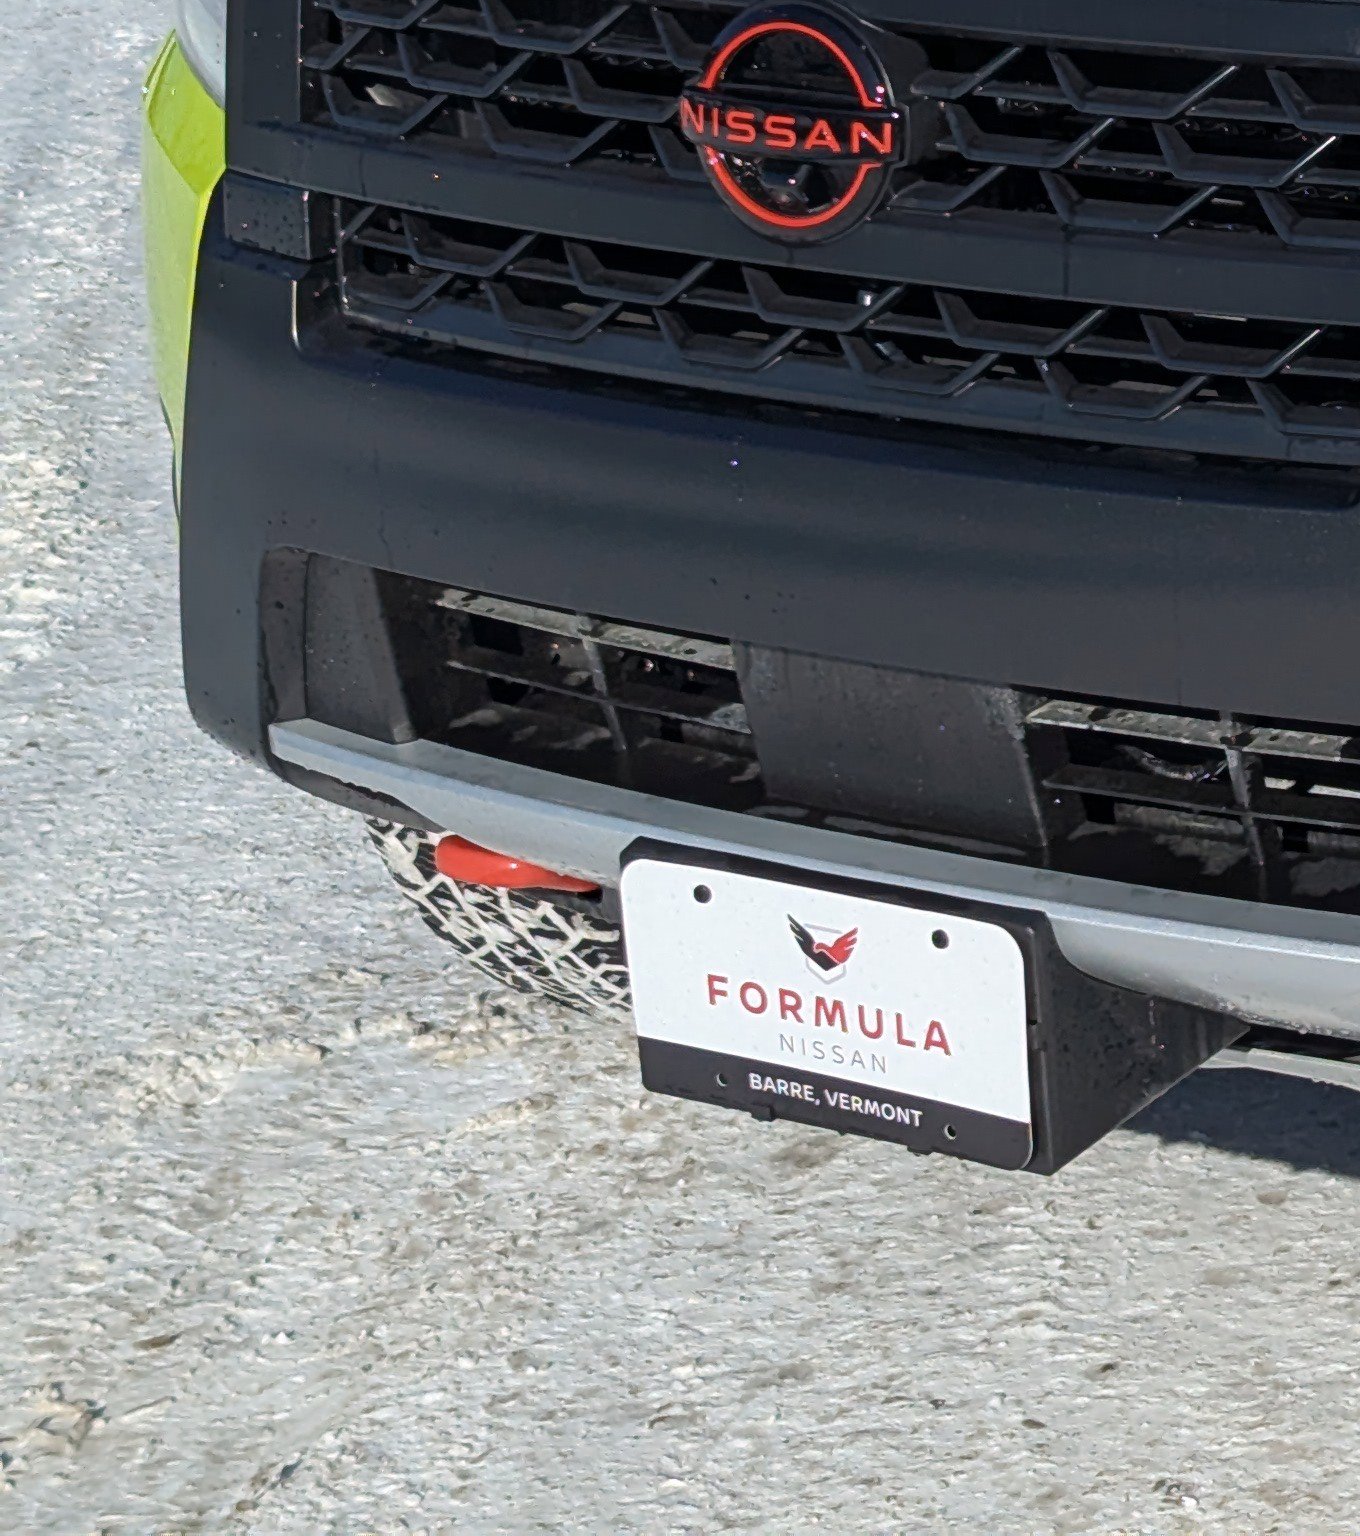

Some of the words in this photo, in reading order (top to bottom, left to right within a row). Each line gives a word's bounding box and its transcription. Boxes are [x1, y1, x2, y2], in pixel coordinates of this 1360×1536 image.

[679, 96, 892, 154] NISSAN
[707, 973, 953, 1057] FORMULA
[778, 1032, 888, 1074] NISSAN
[748, 1071, 821, 1107] BARRE,
[823, 1091, 923, 1128] VERMONT
